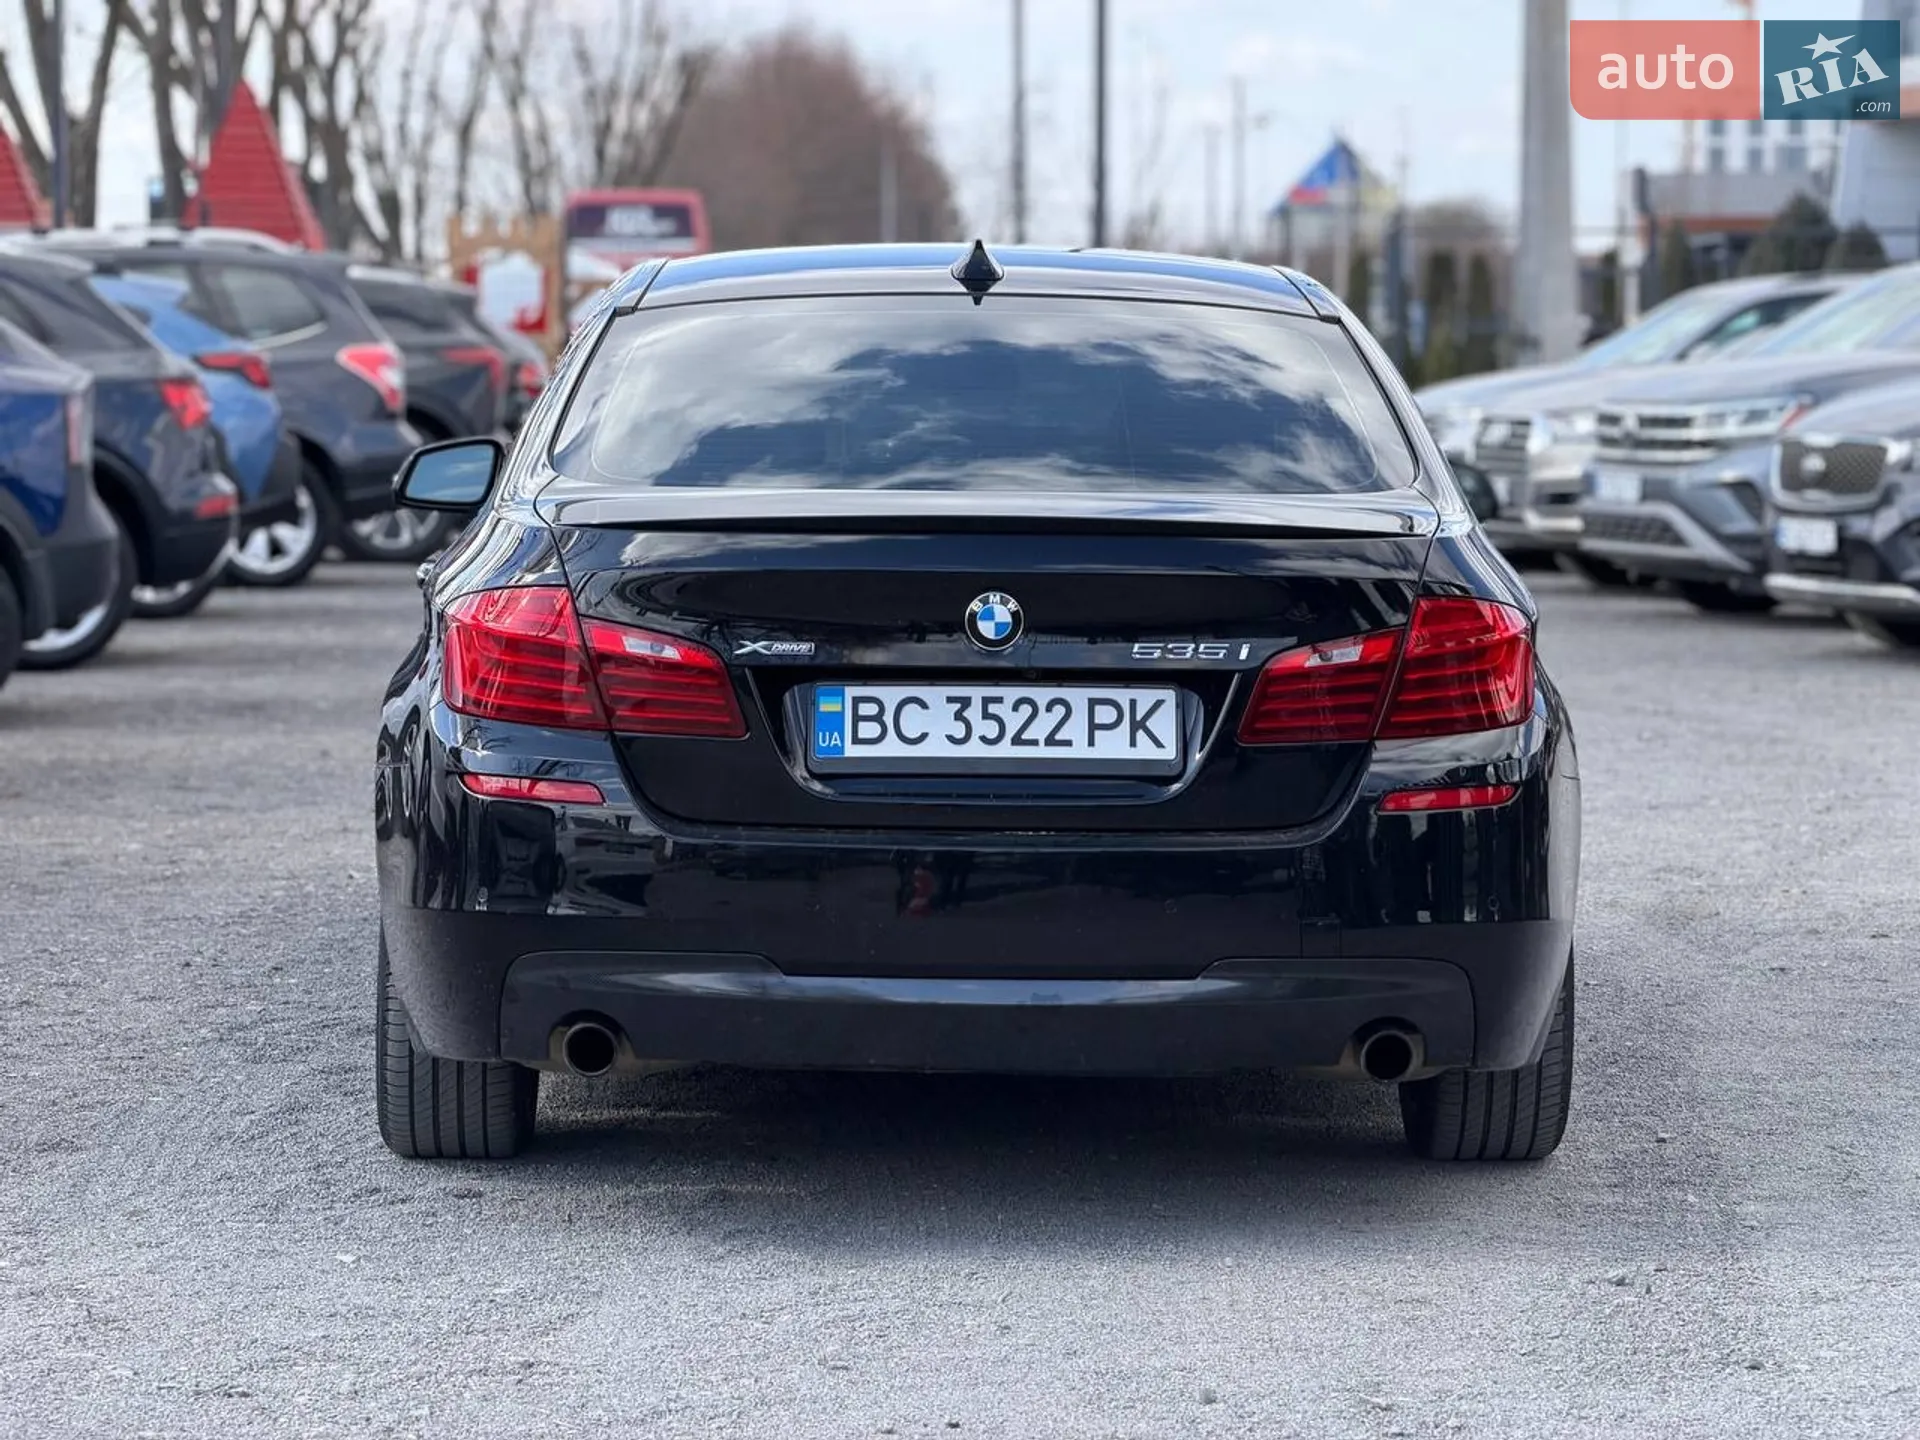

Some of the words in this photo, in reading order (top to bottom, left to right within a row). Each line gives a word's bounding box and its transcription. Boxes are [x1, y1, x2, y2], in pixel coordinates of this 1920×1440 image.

[971, 593, 1019, 613] BMW
[850, 695, 930, 746] BC
[944, 696, 1073, 747] 3522
[1087, 697, 1167, 749] PK
[818, 732, 842, 748] UA
